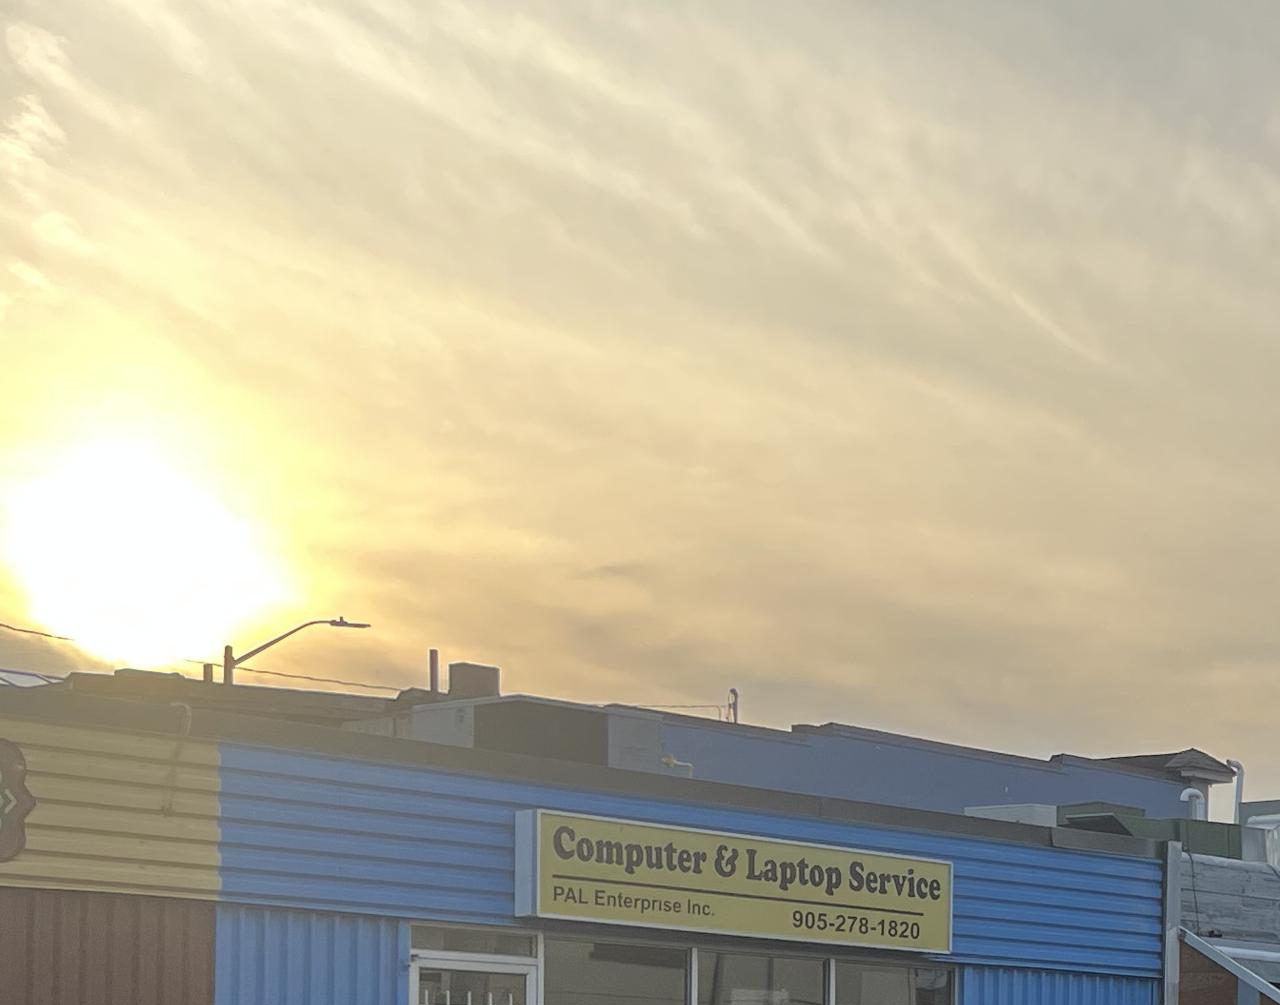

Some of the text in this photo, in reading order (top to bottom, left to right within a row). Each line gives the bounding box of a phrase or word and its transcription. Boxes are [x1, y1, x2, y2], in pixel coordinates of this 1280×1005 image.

[553, 826, 941, 900] Computer & Laptop Service
[553, 886, 715, 916] PAL Enterprise Inc.
[792, 910, 920, 940] 905-278-1820
